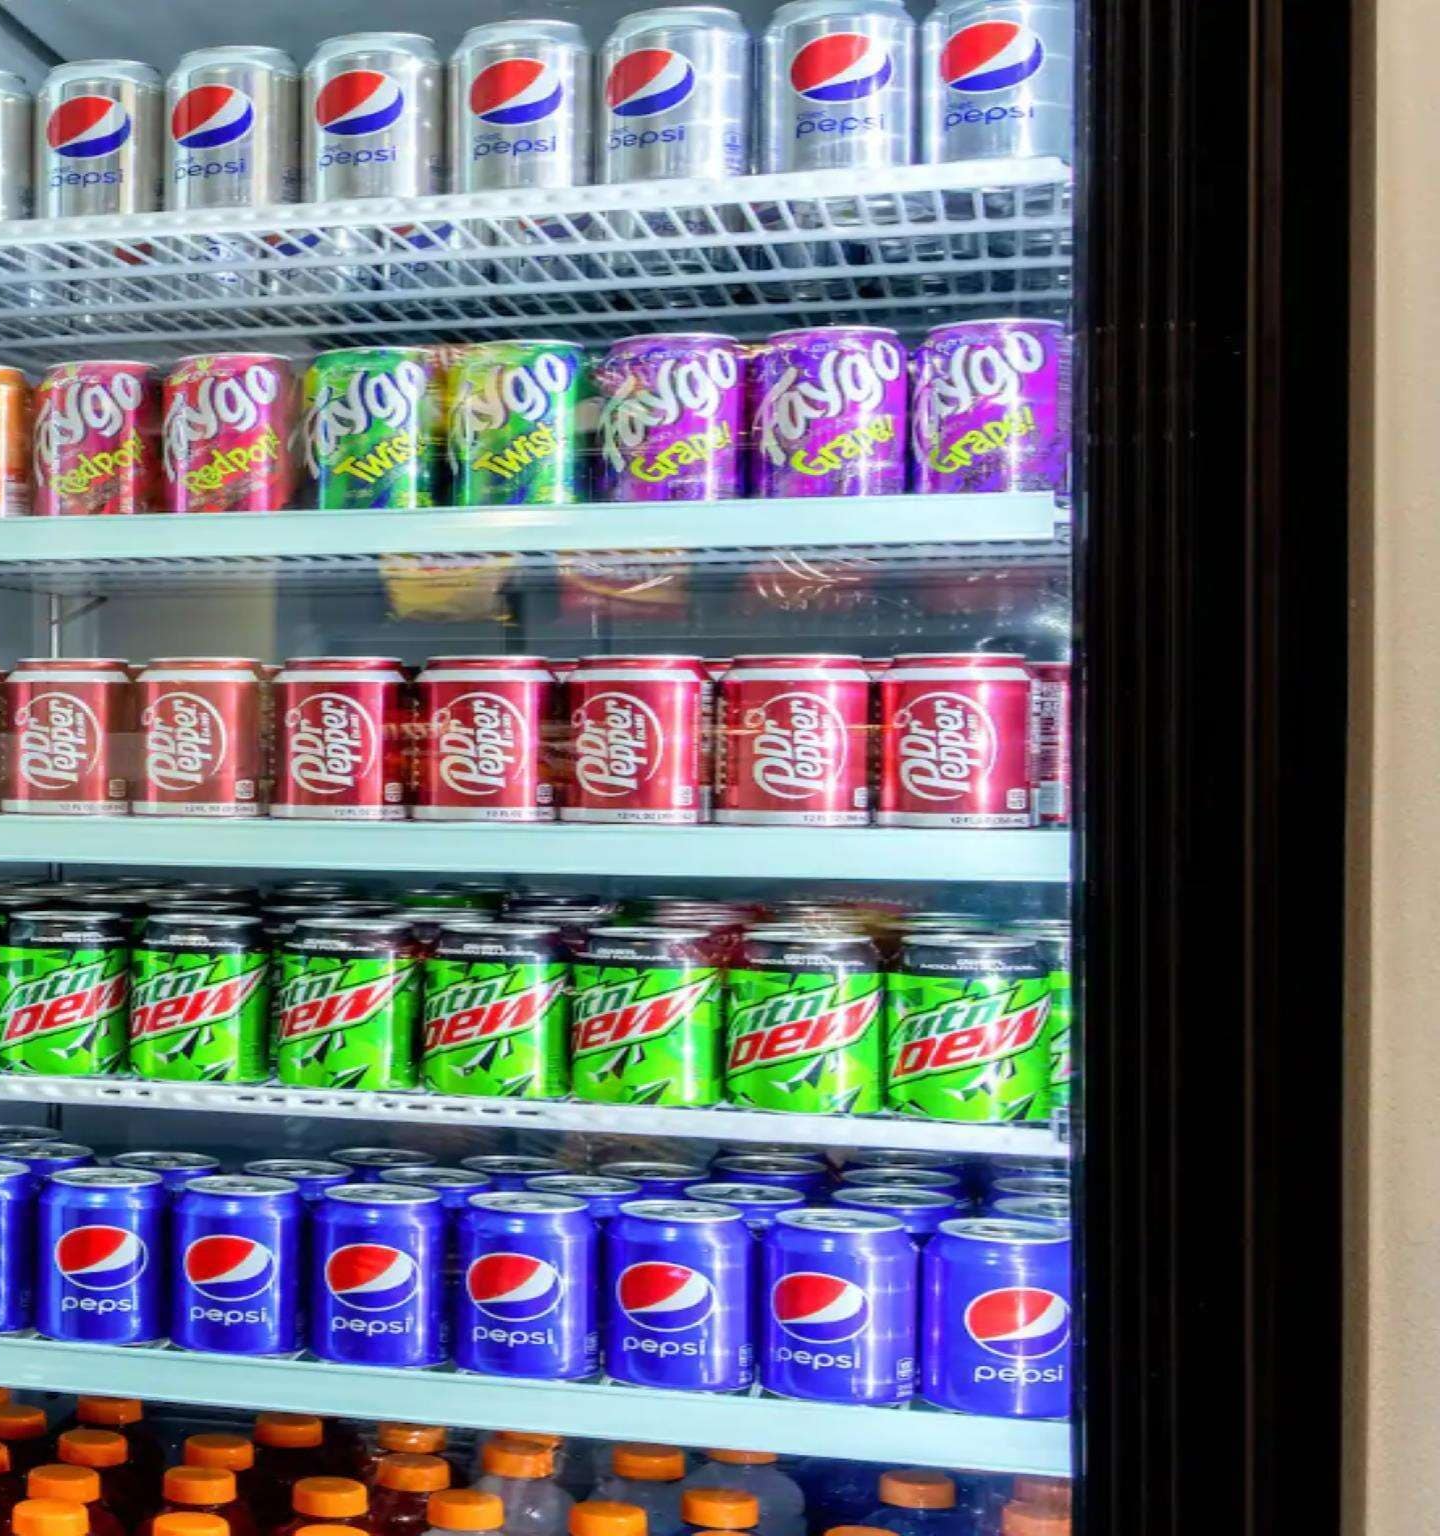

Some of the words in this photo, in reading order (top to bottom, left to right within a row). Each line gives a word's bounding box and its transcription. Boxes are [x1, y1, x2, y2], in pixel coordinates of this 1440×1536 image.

[795, 112, 886, 139] pepsi
[943, 104, 1035, 133] pepsi
[472, 135, 557, 161] pepsi
[607, 125, 686, 151] pepsi
[174, 157, 246, 182] pepsi
[318, 145, 396, 171] pepsi
[753, 339, 900, 467] Faygo
[19, 717, 51, 753] Dr
[19, 700, 87, 790] Pepper
[146, 717, 176, 753] Dr
[146, 700, 212, 791] Pepper
[291, 719, 324, 755] Dr
[291, 700, 363, 794] Pepper
[440, 718, 475, 756] Dr
[440, 700, 515, 796] Pepper
[576, 719, 609, 757] Dr
[576, 700, 647, 797] Pepper
[753, 719, 793, 760] Dr
[753, 700, 834, 799] Pepper
[900, 720, 937, 757] Dr
[900, 700, 983, 801] Pepper
[62, 1295, 139, 1315] pepsi
[190, 1305, 268, 1327] pepsi
[331, 1314, 413, 1337] pepsi
[472, 1324, 554, 1348] pepsi
[622, 1334, 707, 1358] pepsi
[775, 1345, 861, 1371] pepsi
[973, 1364, 1065, 1386] pepsi
